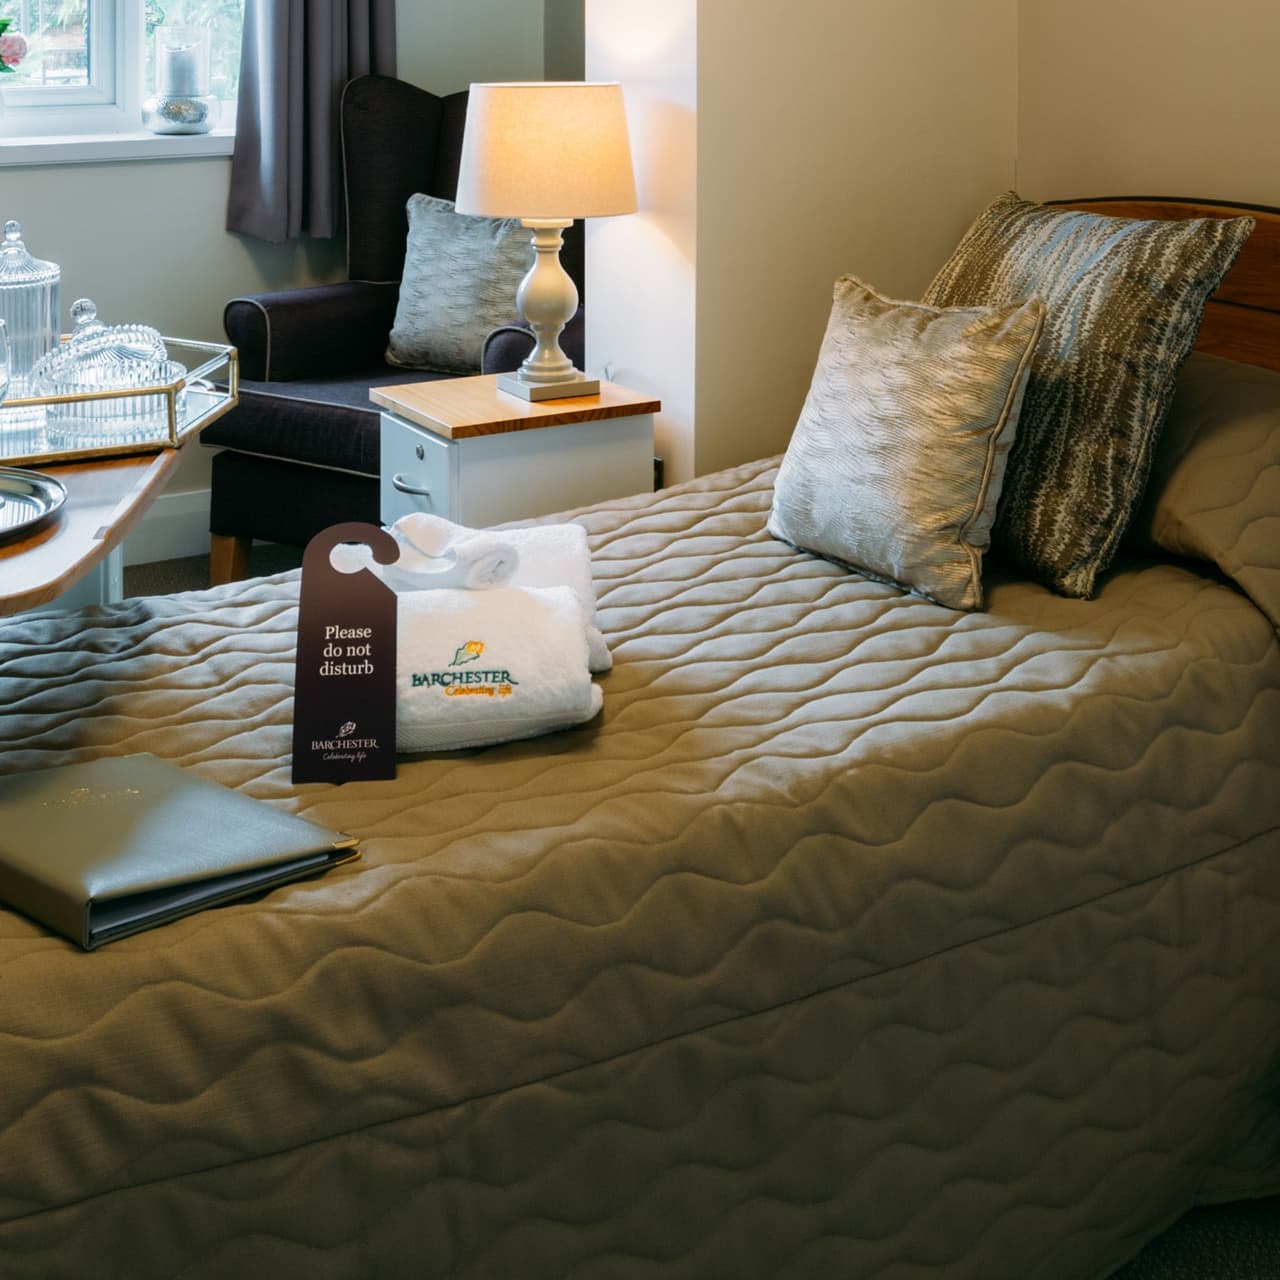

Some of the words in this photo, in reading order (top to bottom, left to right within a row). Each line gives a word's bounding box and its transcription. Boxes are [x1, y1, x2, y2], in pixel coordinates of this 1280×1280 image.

[324, 624, 372, 640] Please
[323, 642, 343, 657] do
[346, 643, 372, 657] not
[319, 659, 374, 676] disturb
[411, 670, 519, 688] BARCHESTER
[444, 684, 496, 698] Celebrating
[498, 684, 513, 698] life
[311, 738, 380, 750] BARCHESTER
[322, 751, 356, 763] Celebrating
[356, 751, 367, 763] life
